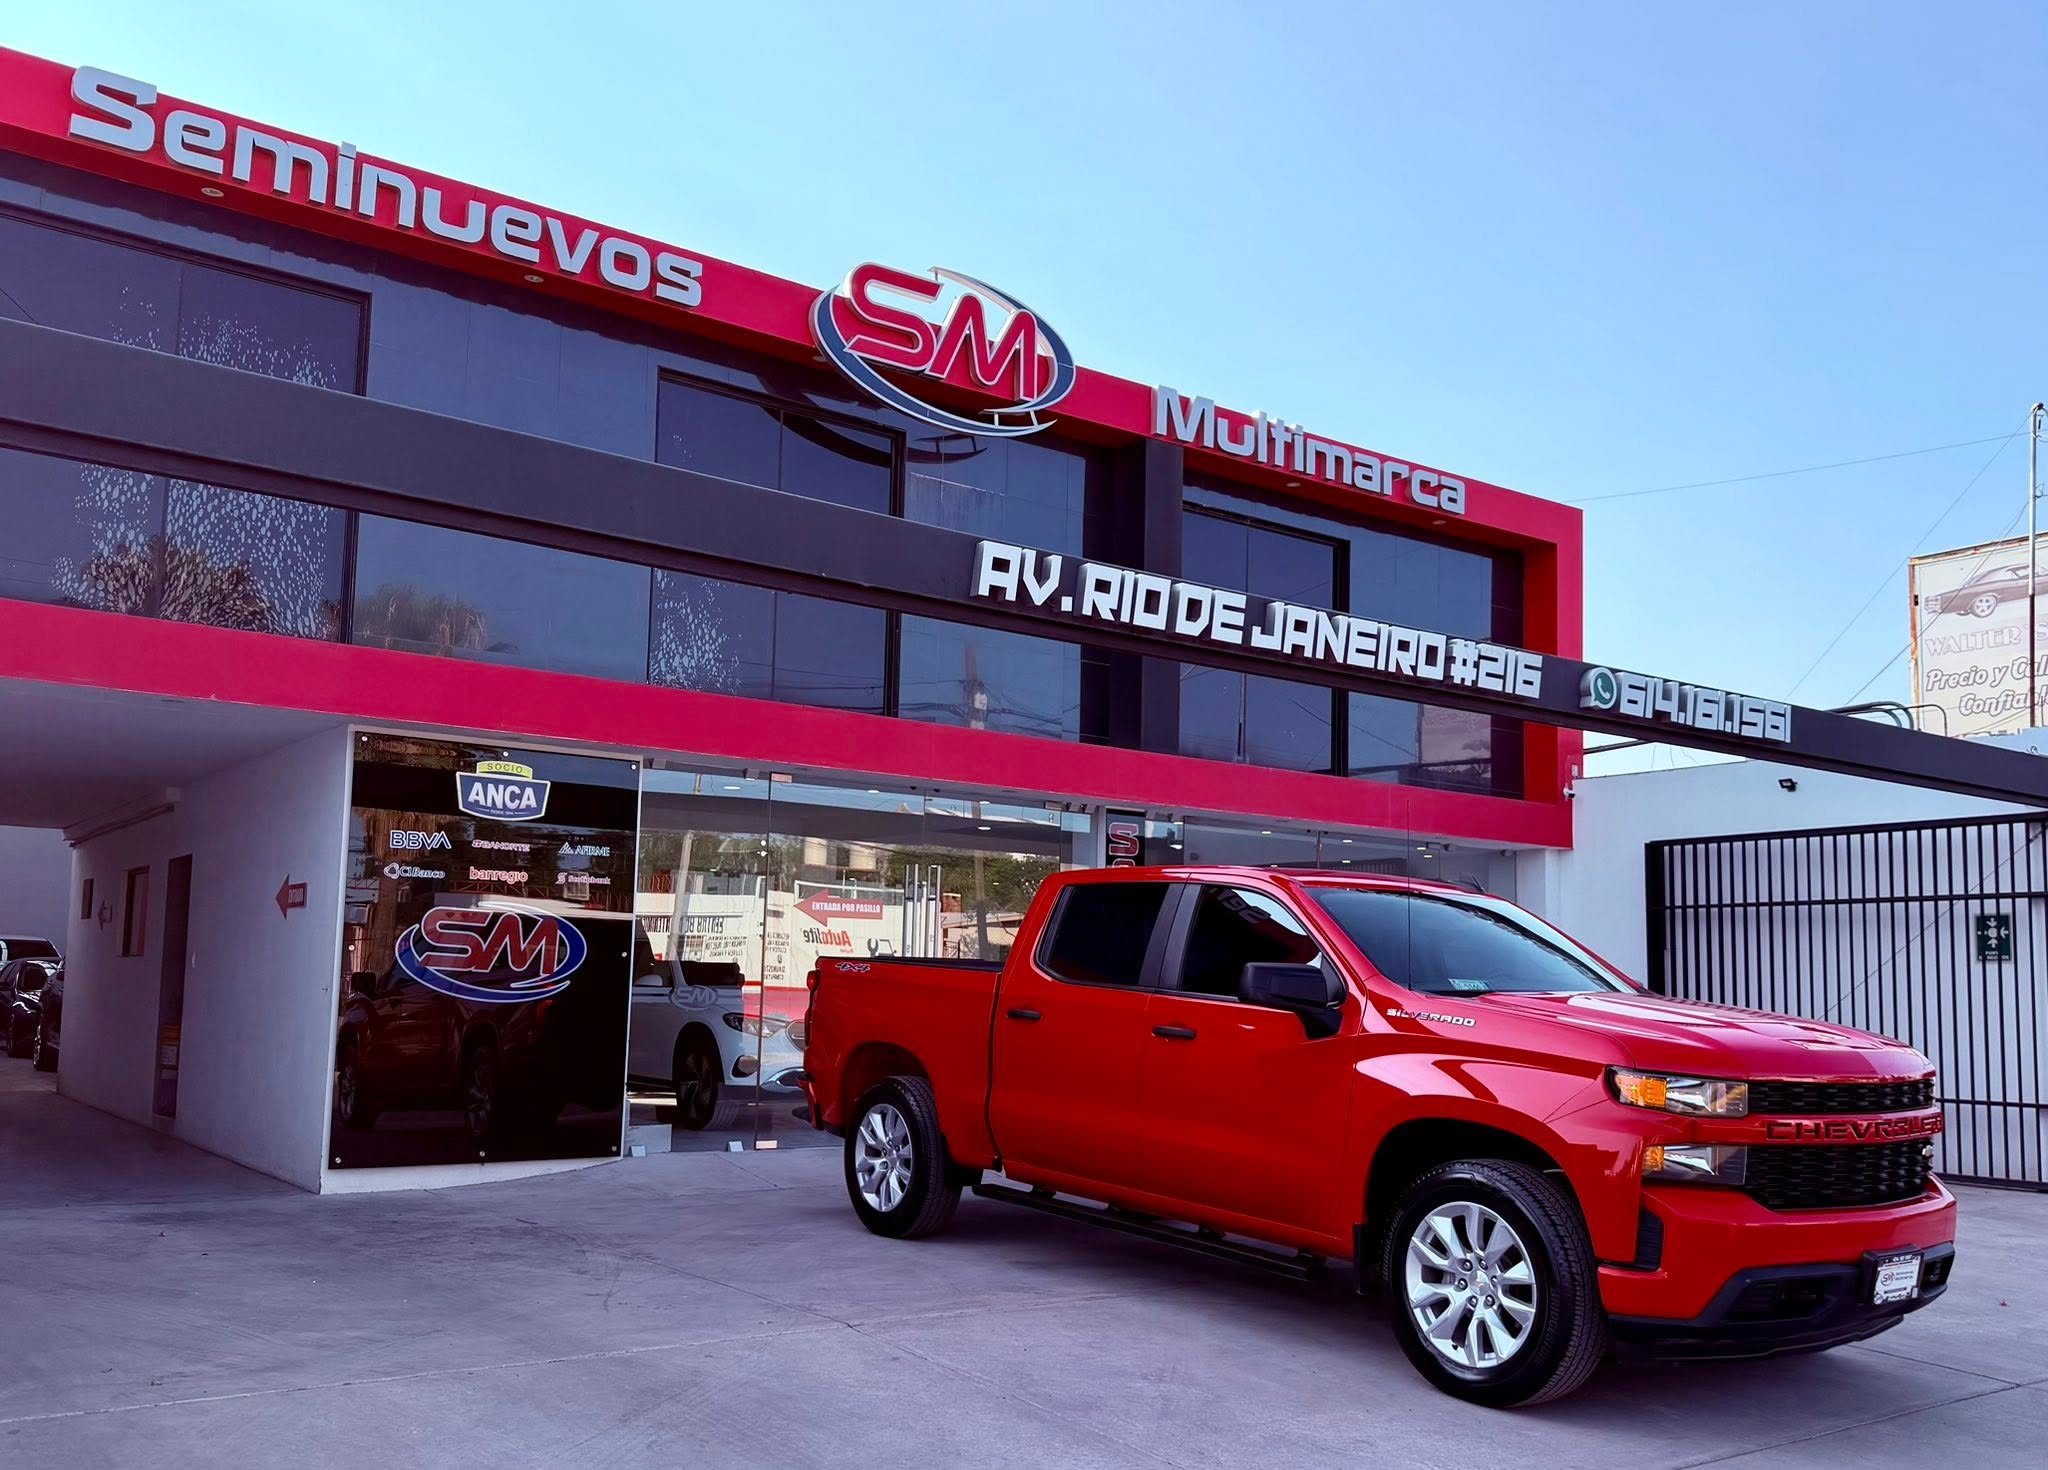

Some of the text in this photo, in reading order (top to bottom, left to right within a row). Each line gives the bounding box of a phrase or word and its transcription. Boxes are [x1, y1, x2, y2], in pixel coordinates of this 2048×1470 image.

[70, 65, 703, 307] Seminuevos
[842, 262, 1038, 401] SM
[1152, 384, 1466, 515] Multimarca
[970, 540, 1543, 699] AV. RIO DE JANEIRO #216
[1926, 665, 1989, 691] Precio
[1990, 664, 2010, 688] y
[487, 763, 523, 774] SOCIO
[467, 782, 537, 810] ANCA
[389, 830, 452, 850] BBVA
[575, 845, 610, 857] AFIRME
[469, 865, 529, 885] banregio
[811, 902, 881, 913] ENTRADA POR PASILLO
[418, 906, 560, 975] SM
[1386, 1008, 1477, 1027] SILVERADO
